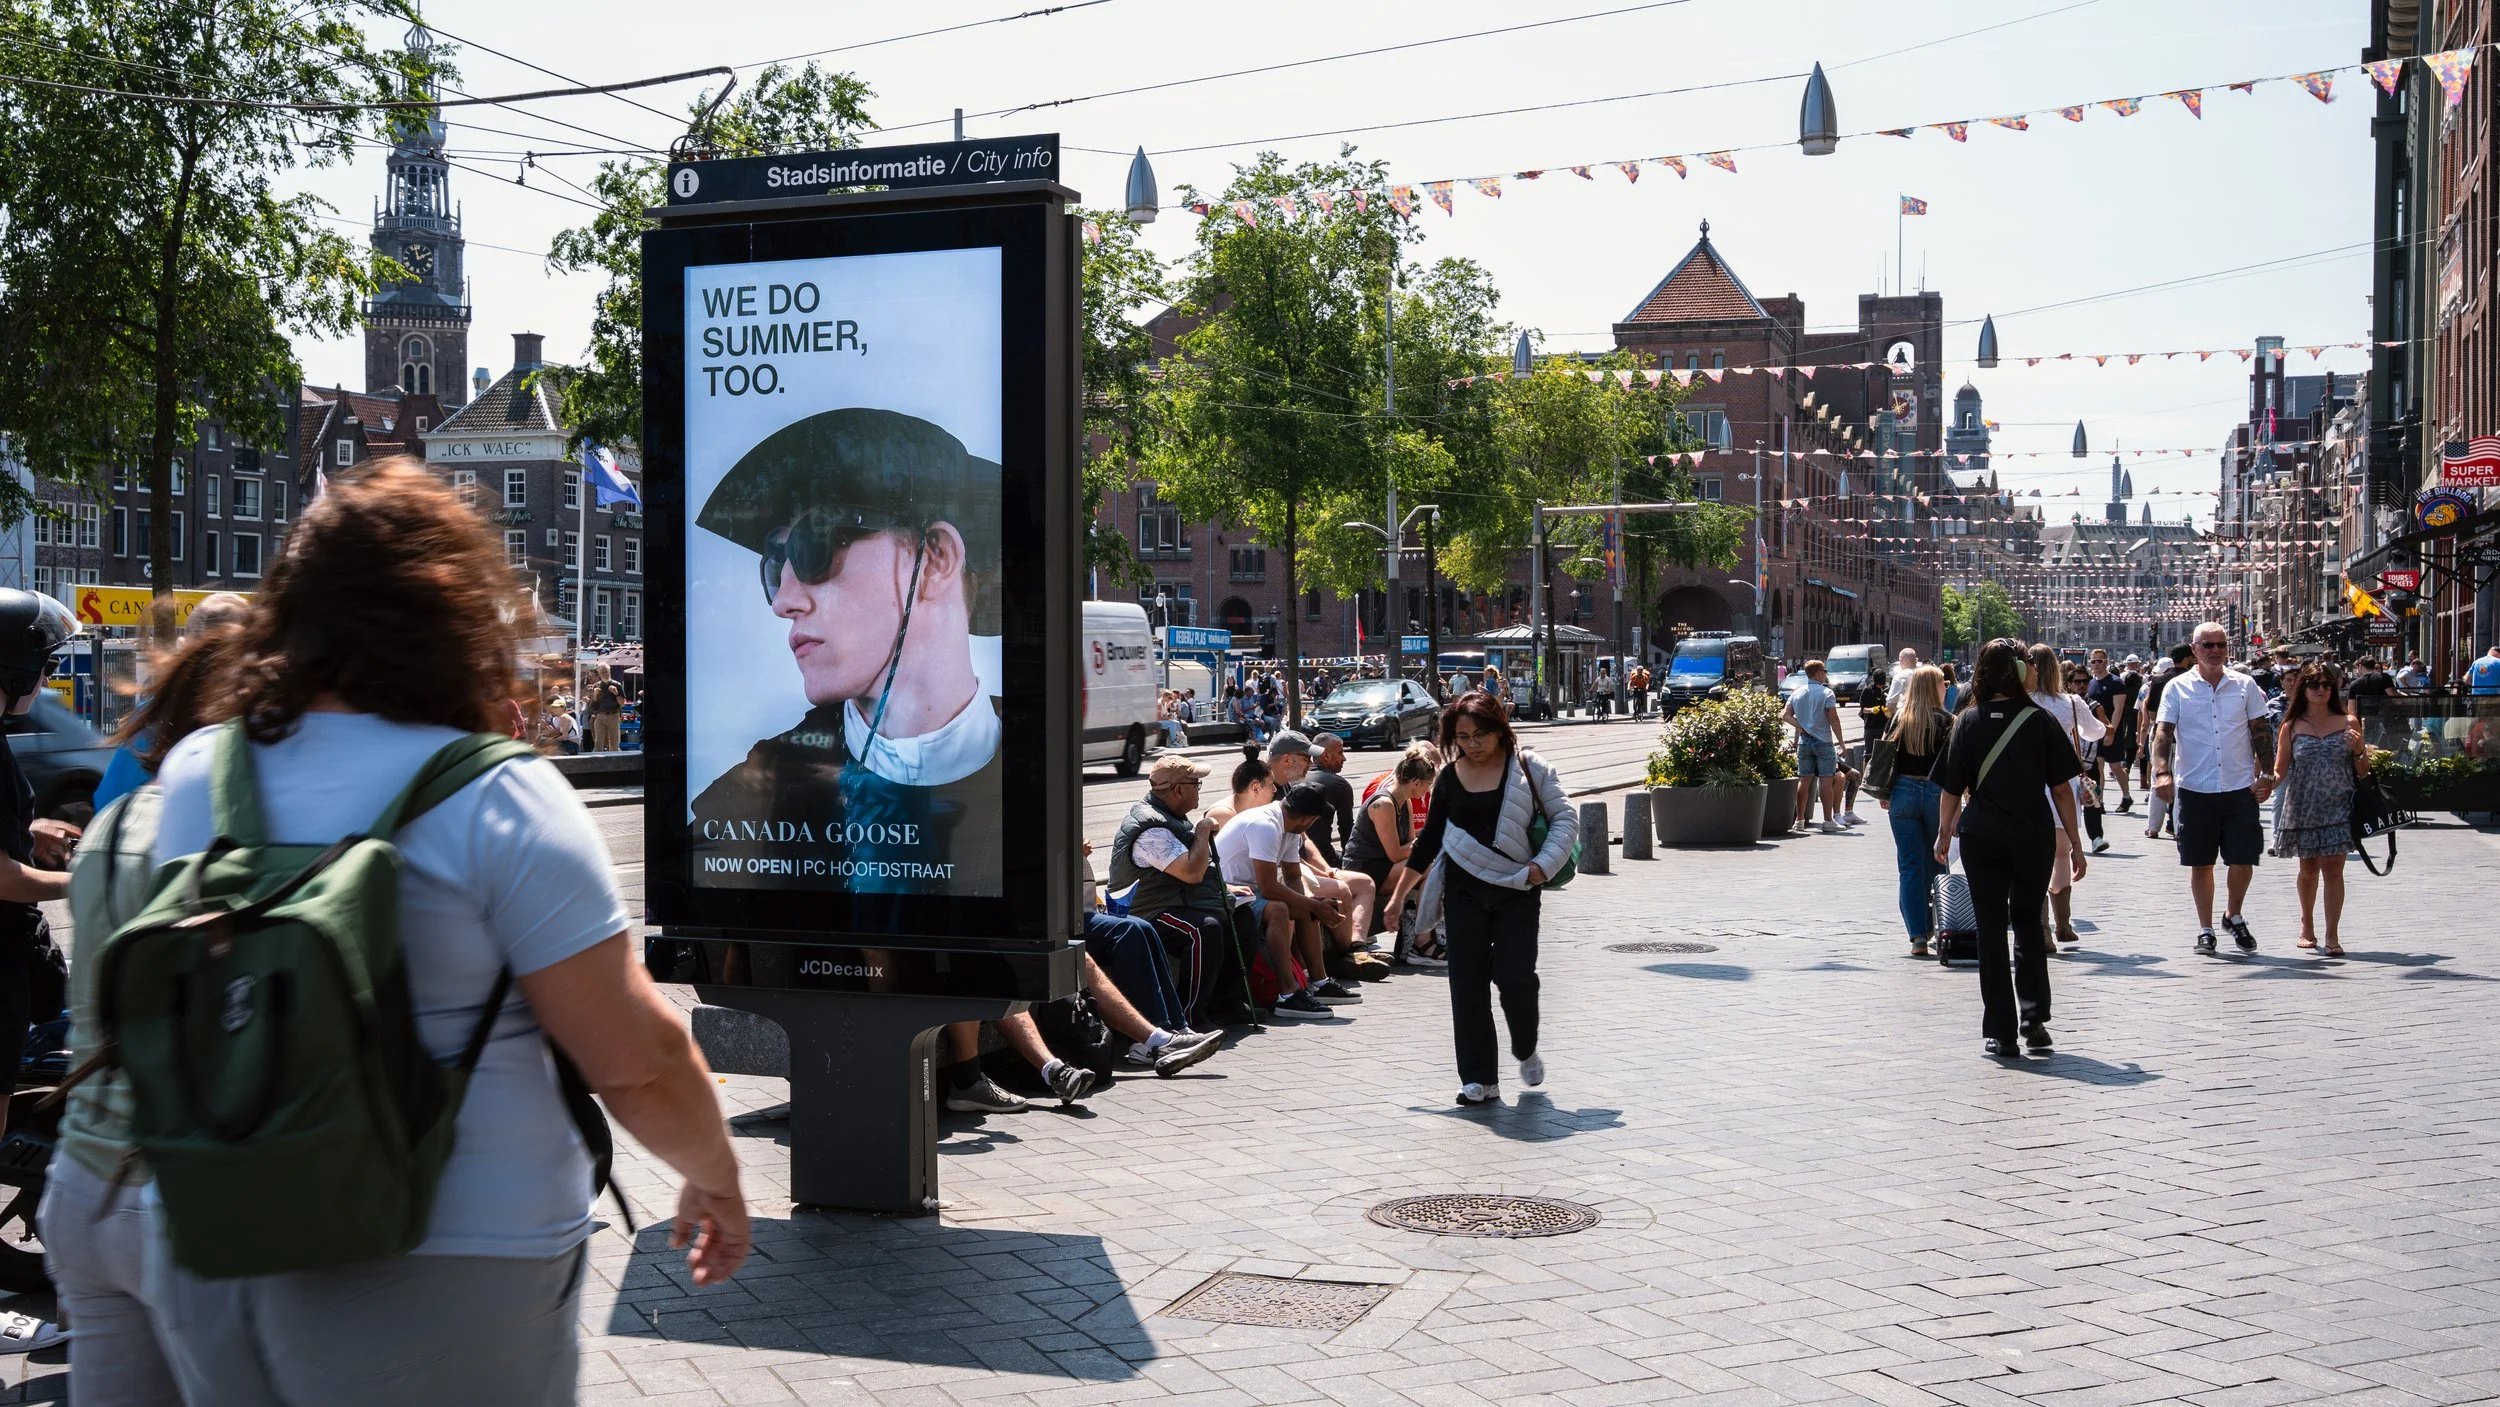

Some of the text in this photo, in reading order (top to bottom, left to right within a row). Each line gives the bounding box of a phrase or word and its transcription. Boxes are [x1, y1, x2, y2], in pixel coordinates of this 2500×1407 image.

[766, 154, 946, 187] Stadsinformatie
[967, 149, 1010, 175] City
[1013, 146, 1052, 170] info
[702, 281, 820, 319] WE DO
[702, 319, 868, 358] SUMMER,
[702, 363, 785, 397] TOO.
[2444, 475, 2500, 487] MARKET
[2450, 465, 2494, 476] SUPER
[2417, 486, 2473, 504] THE BULLDOG
[1106, 642, 1147, 660] Brouwer
[703, 819, 920, 846] CANADA GOOSE
[704, 857, 742, 874] NOW
[747, 858, 792, 875] OPEN
[803, 860, 826, 876] PC
[830, 861, 955, 880] HOOFDSTRAAT
[799, 960, 884, 978] JCDecaux
